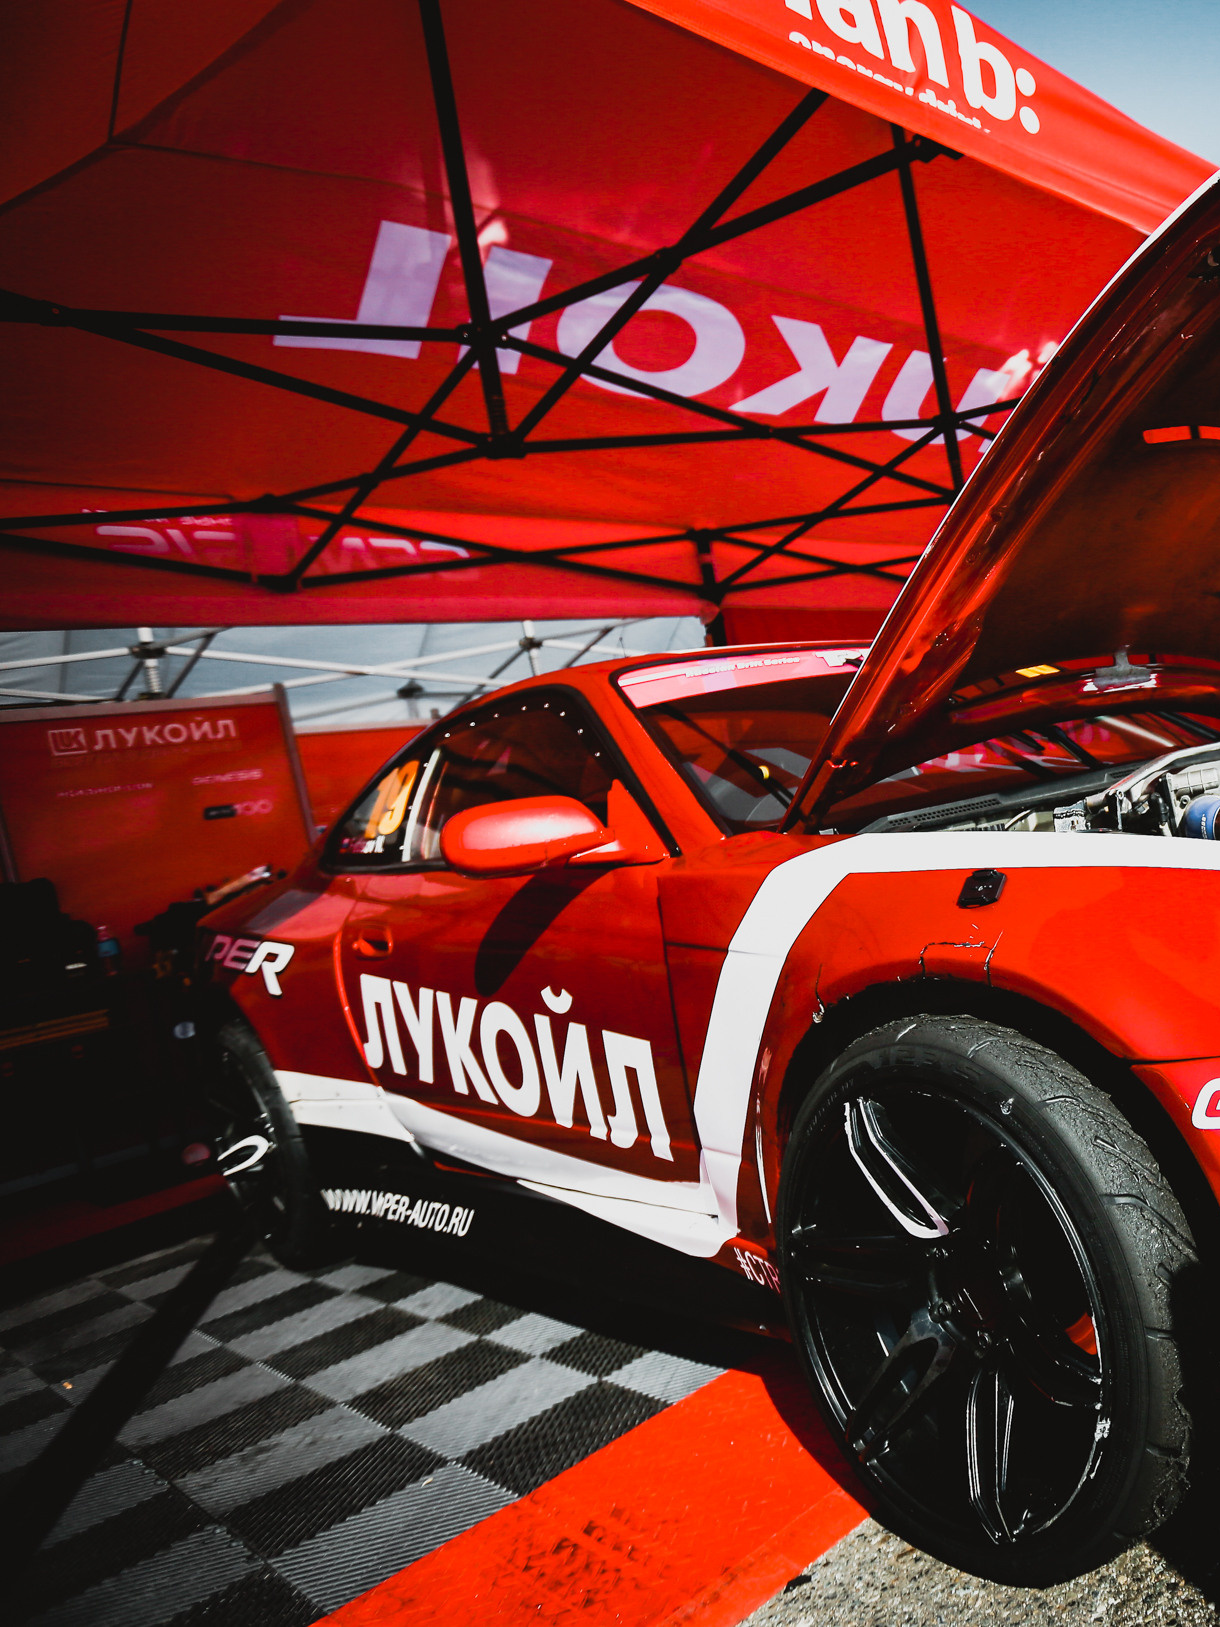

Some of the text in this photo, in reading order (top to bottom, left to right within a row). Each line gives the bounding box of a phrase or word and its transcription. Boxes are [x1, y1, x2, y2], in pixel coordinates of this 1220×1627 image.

[785, 0, 950, 88] an
[93, 716, 237, 750] ЛУКОЙЛ
[360, 973, 675, 1162] ЛУКОЙЛ
[320, 1187, 476, 1238] WWW.VIPER-AUTO.RU
[733, 1246, 781, 1294] #CTR
